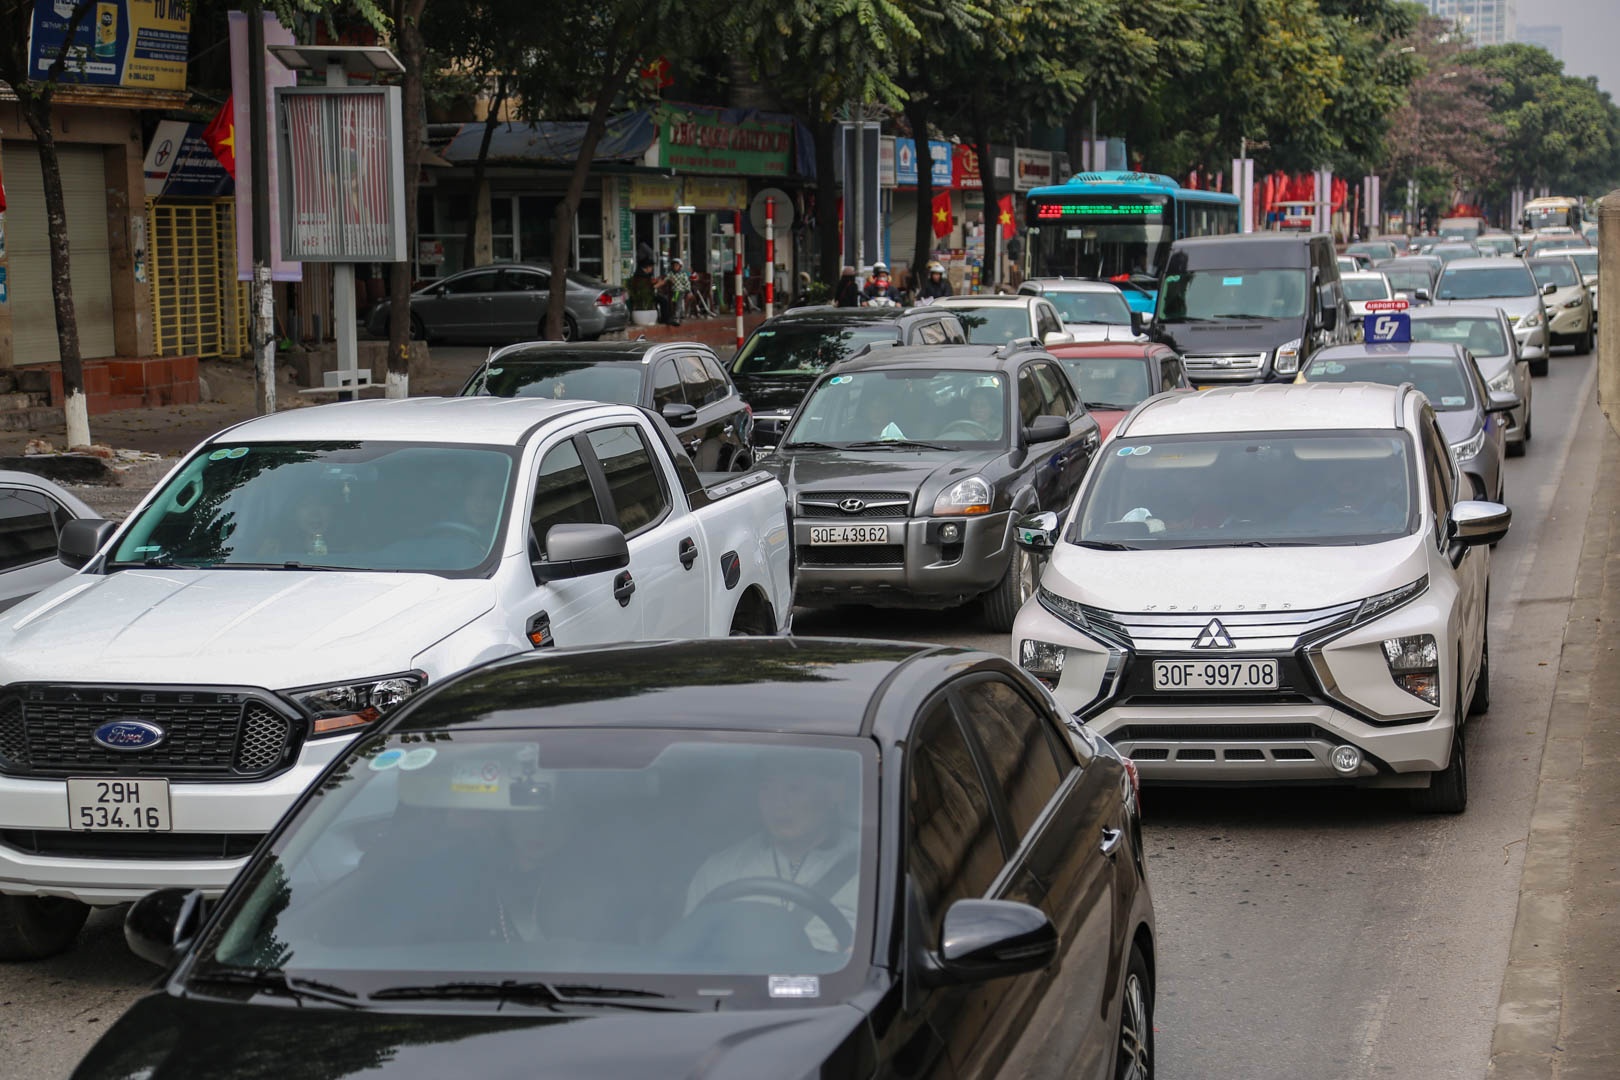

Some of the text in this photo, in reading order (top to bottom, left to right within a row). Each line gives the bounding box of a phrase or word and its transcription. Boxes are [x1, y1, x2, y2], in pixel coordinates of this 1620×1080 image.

[1374, 316, 1399, 341] G7
[813, 527, 886, 543] 30E-439.62
[1157, 664, 1274, 686] 30F-997.08
[29, 690, 232, 704] RANGER
[106, 725, 145, 743] Ford
[97, 782, 140, 804] 29H
[80, 806, 160, 829] 534.16
